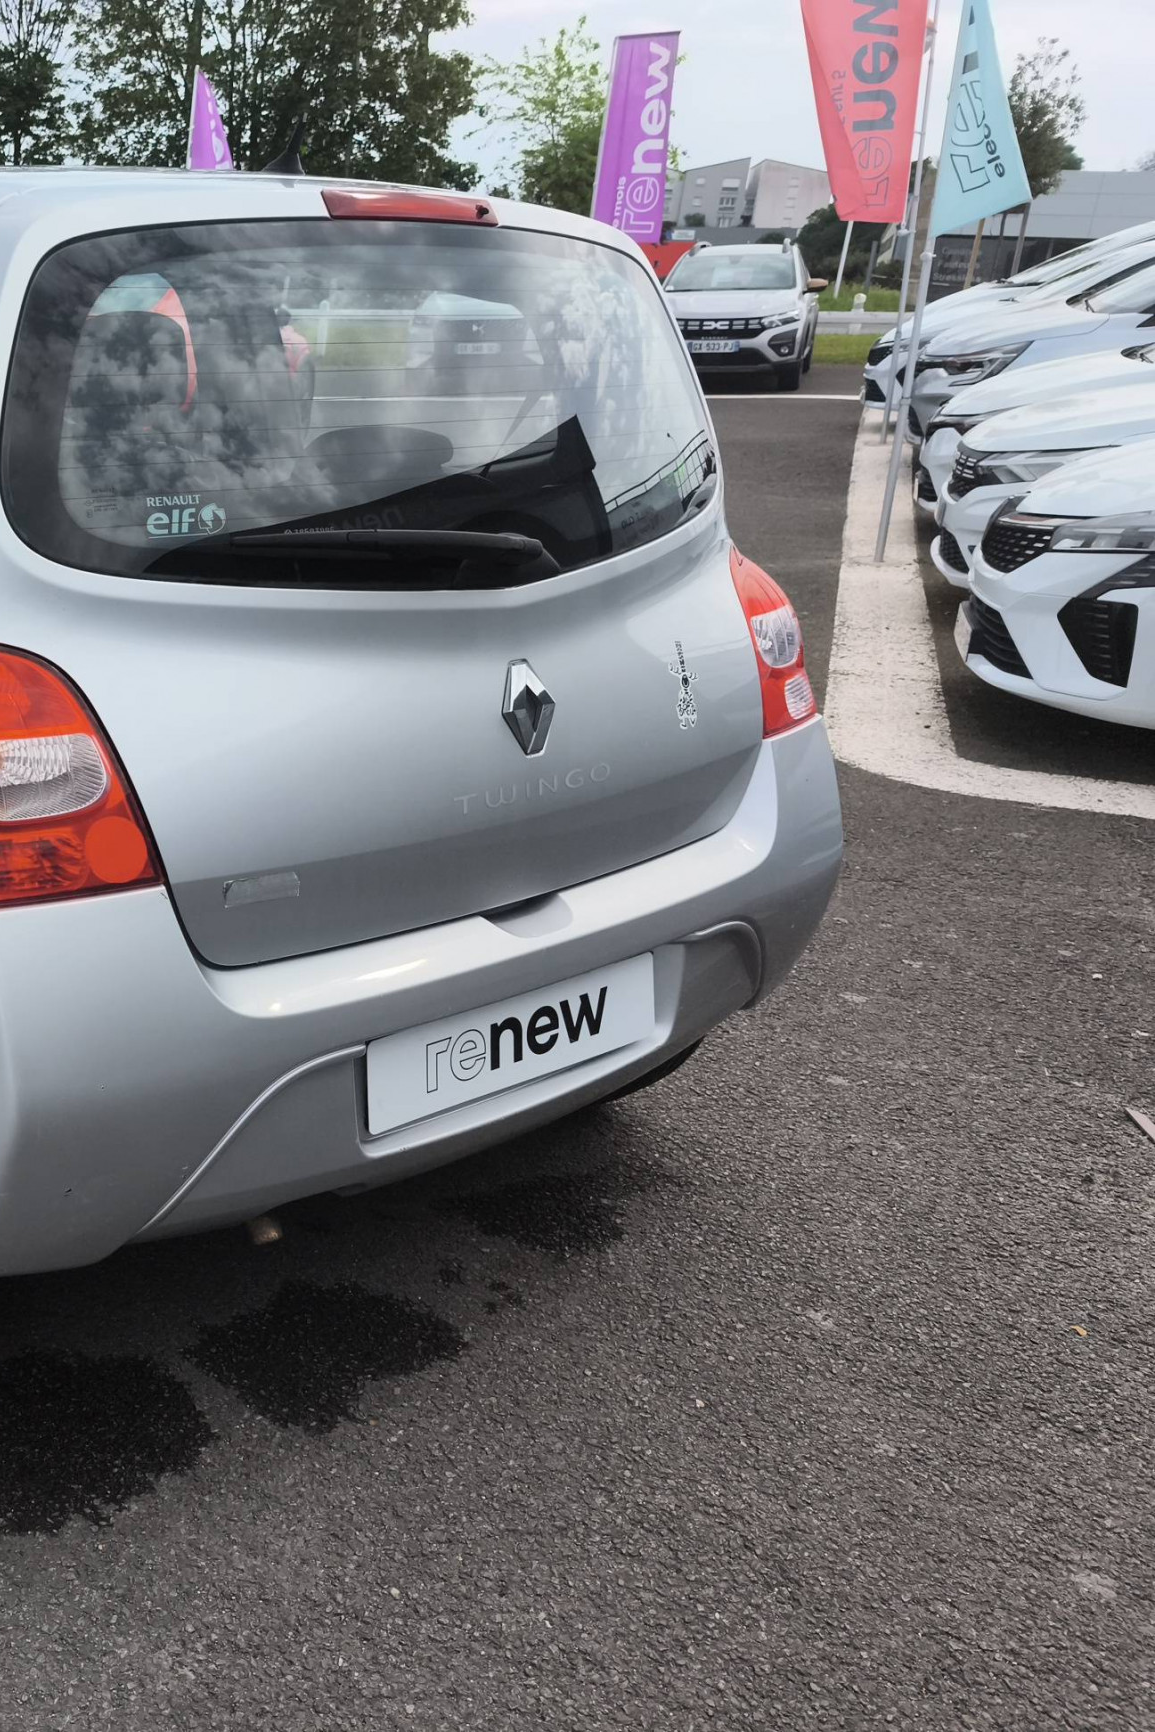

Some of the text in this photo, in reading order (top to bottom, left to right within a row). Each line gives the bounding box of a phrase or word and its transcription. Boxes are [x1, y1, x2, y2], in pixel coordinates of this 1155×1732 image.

[620, 42, 670, 234] renew
[614, 176, 626, 216] mois
[146, 494, 201, 507] RENAULT
[146, 508, 196, 535] elf
[453, 762, 611, 815] TWINGO
[426, 986, 608, 1094] renew
